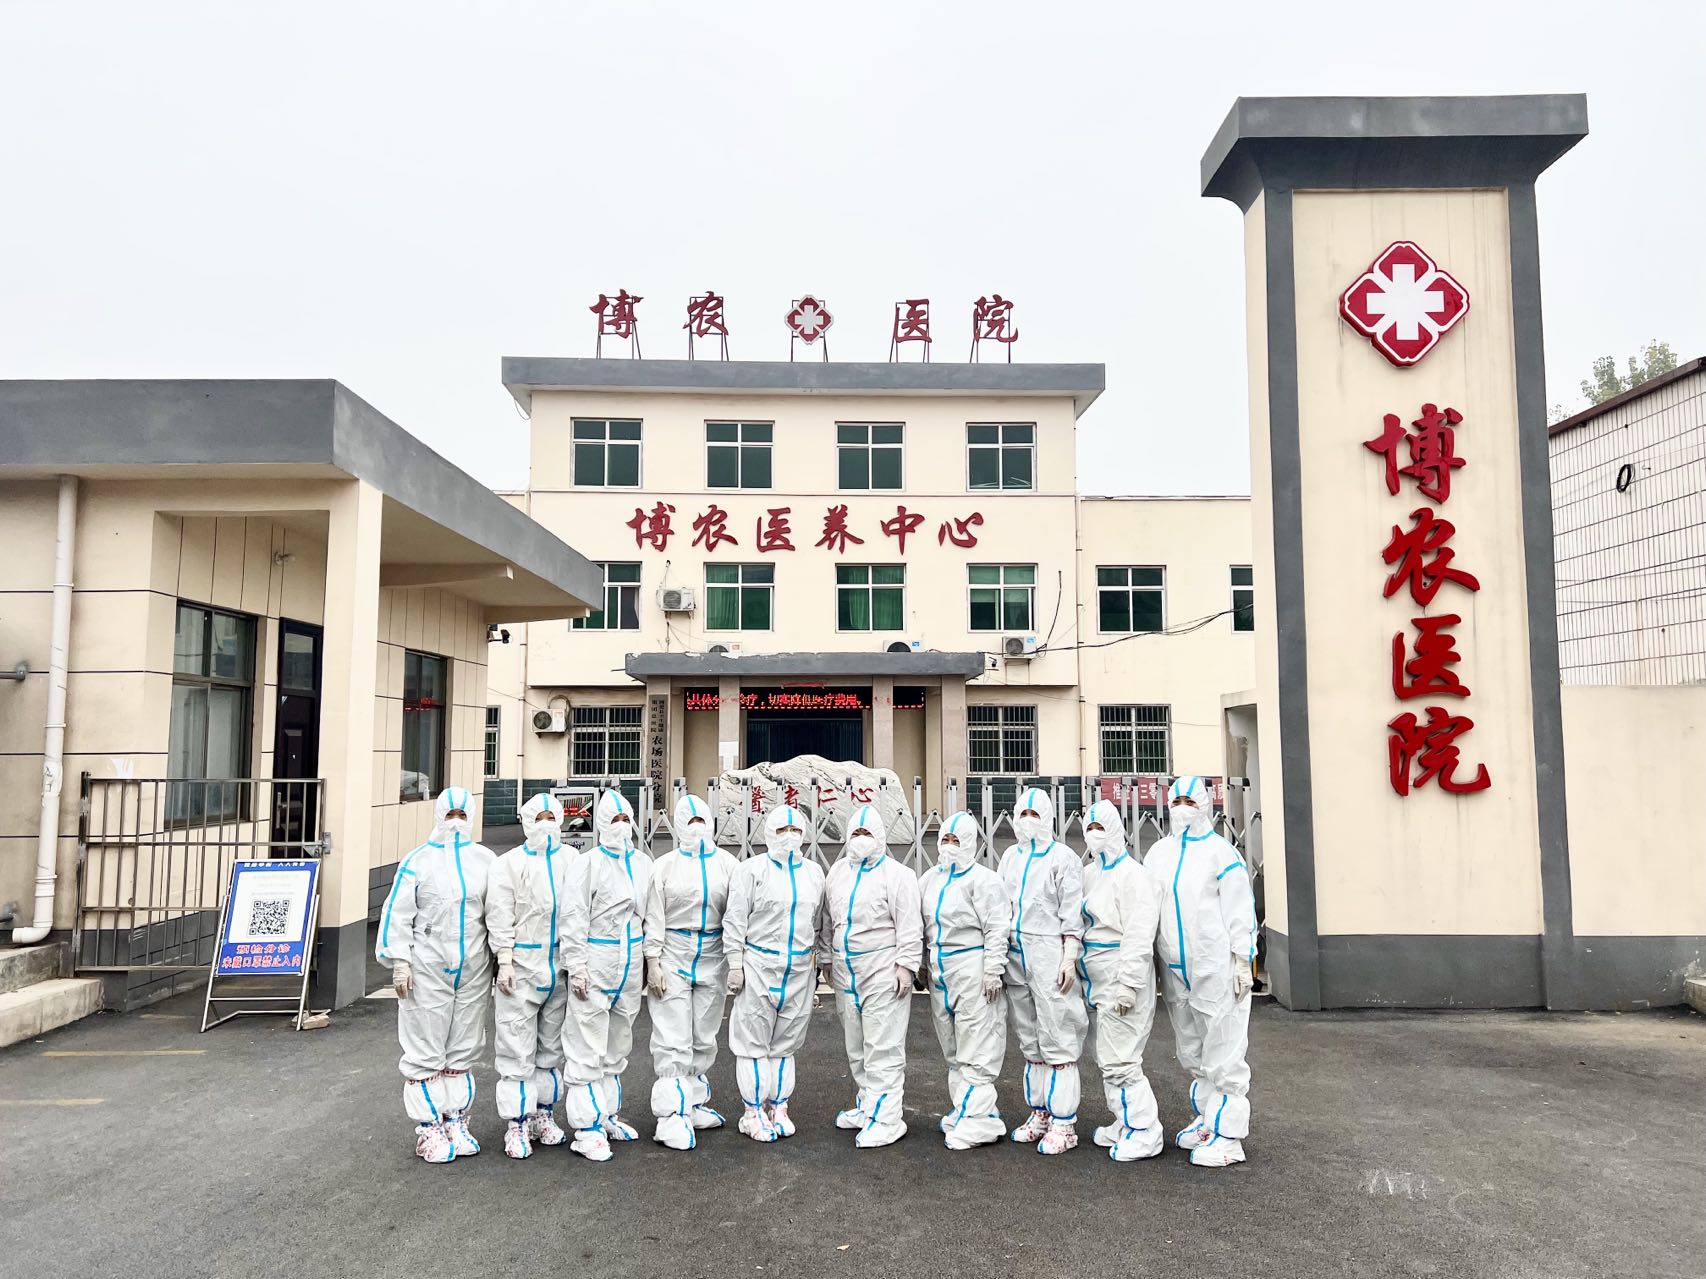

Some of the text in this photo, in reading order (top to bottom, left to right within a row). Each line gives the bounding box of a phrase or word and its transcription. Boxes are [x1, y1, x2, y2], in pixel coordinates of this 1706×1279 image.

[588, 288, 1018, 344] 博农医院
[626, 501, 984, 556] 博农医养中心
[1363, 402, 1491, 797] 博农医院
